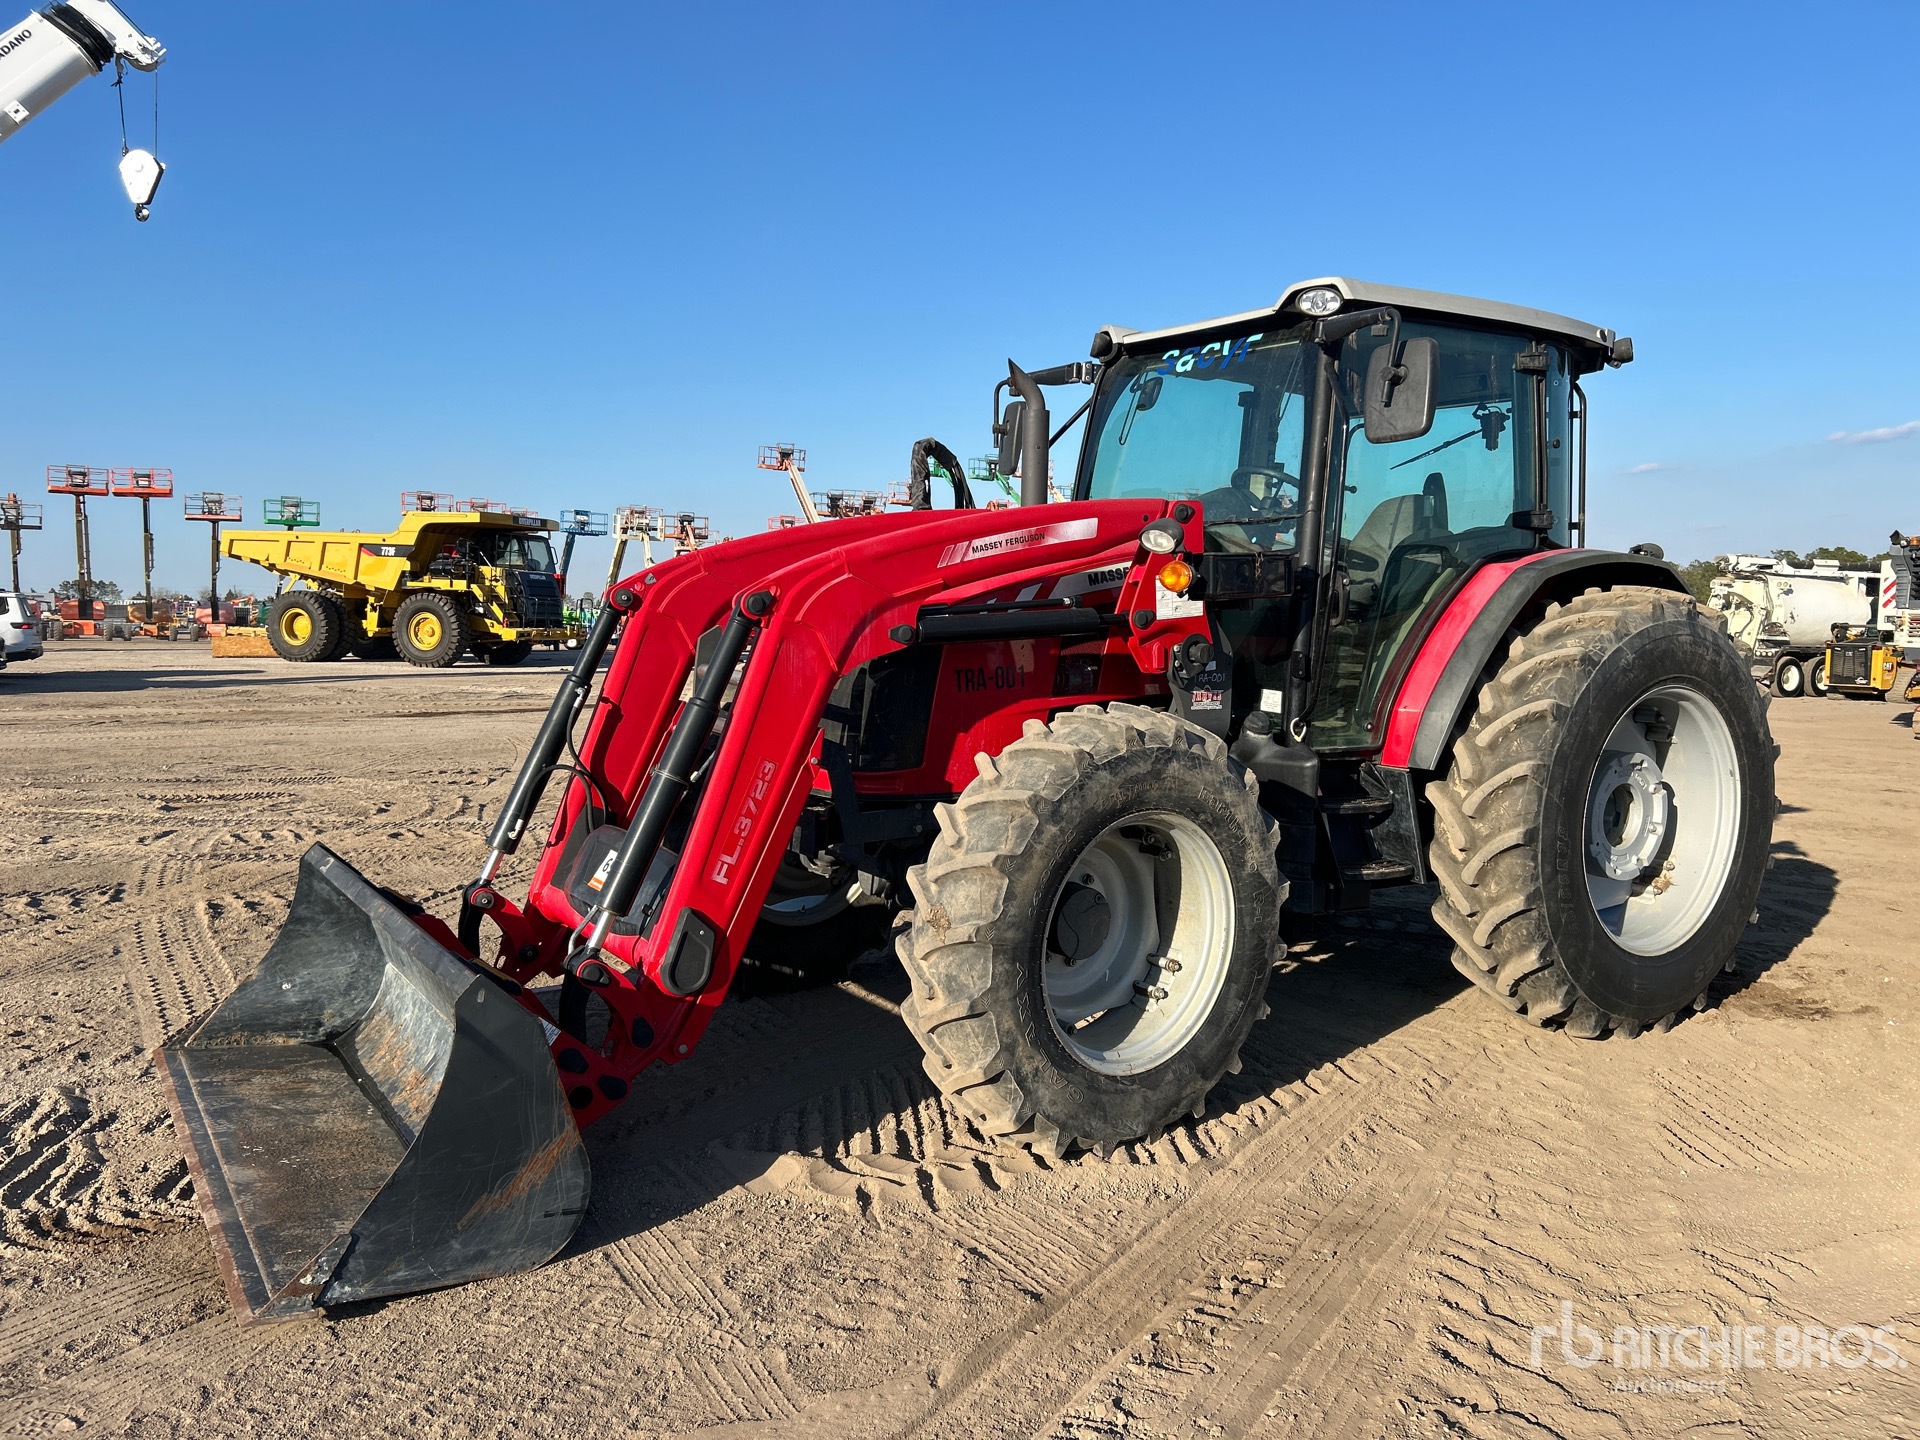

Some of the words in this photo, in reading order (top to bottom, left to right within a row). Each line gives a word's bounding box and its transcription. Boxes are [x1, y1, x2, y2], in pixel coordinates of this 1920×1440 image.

[971, 540, 1003, 555] MASSEY
[1005, 532, 1045, 547] FERGUSON
[1883, 662, 1892, 671] CAT
[954, 664, 1025, 693] TRA-001
